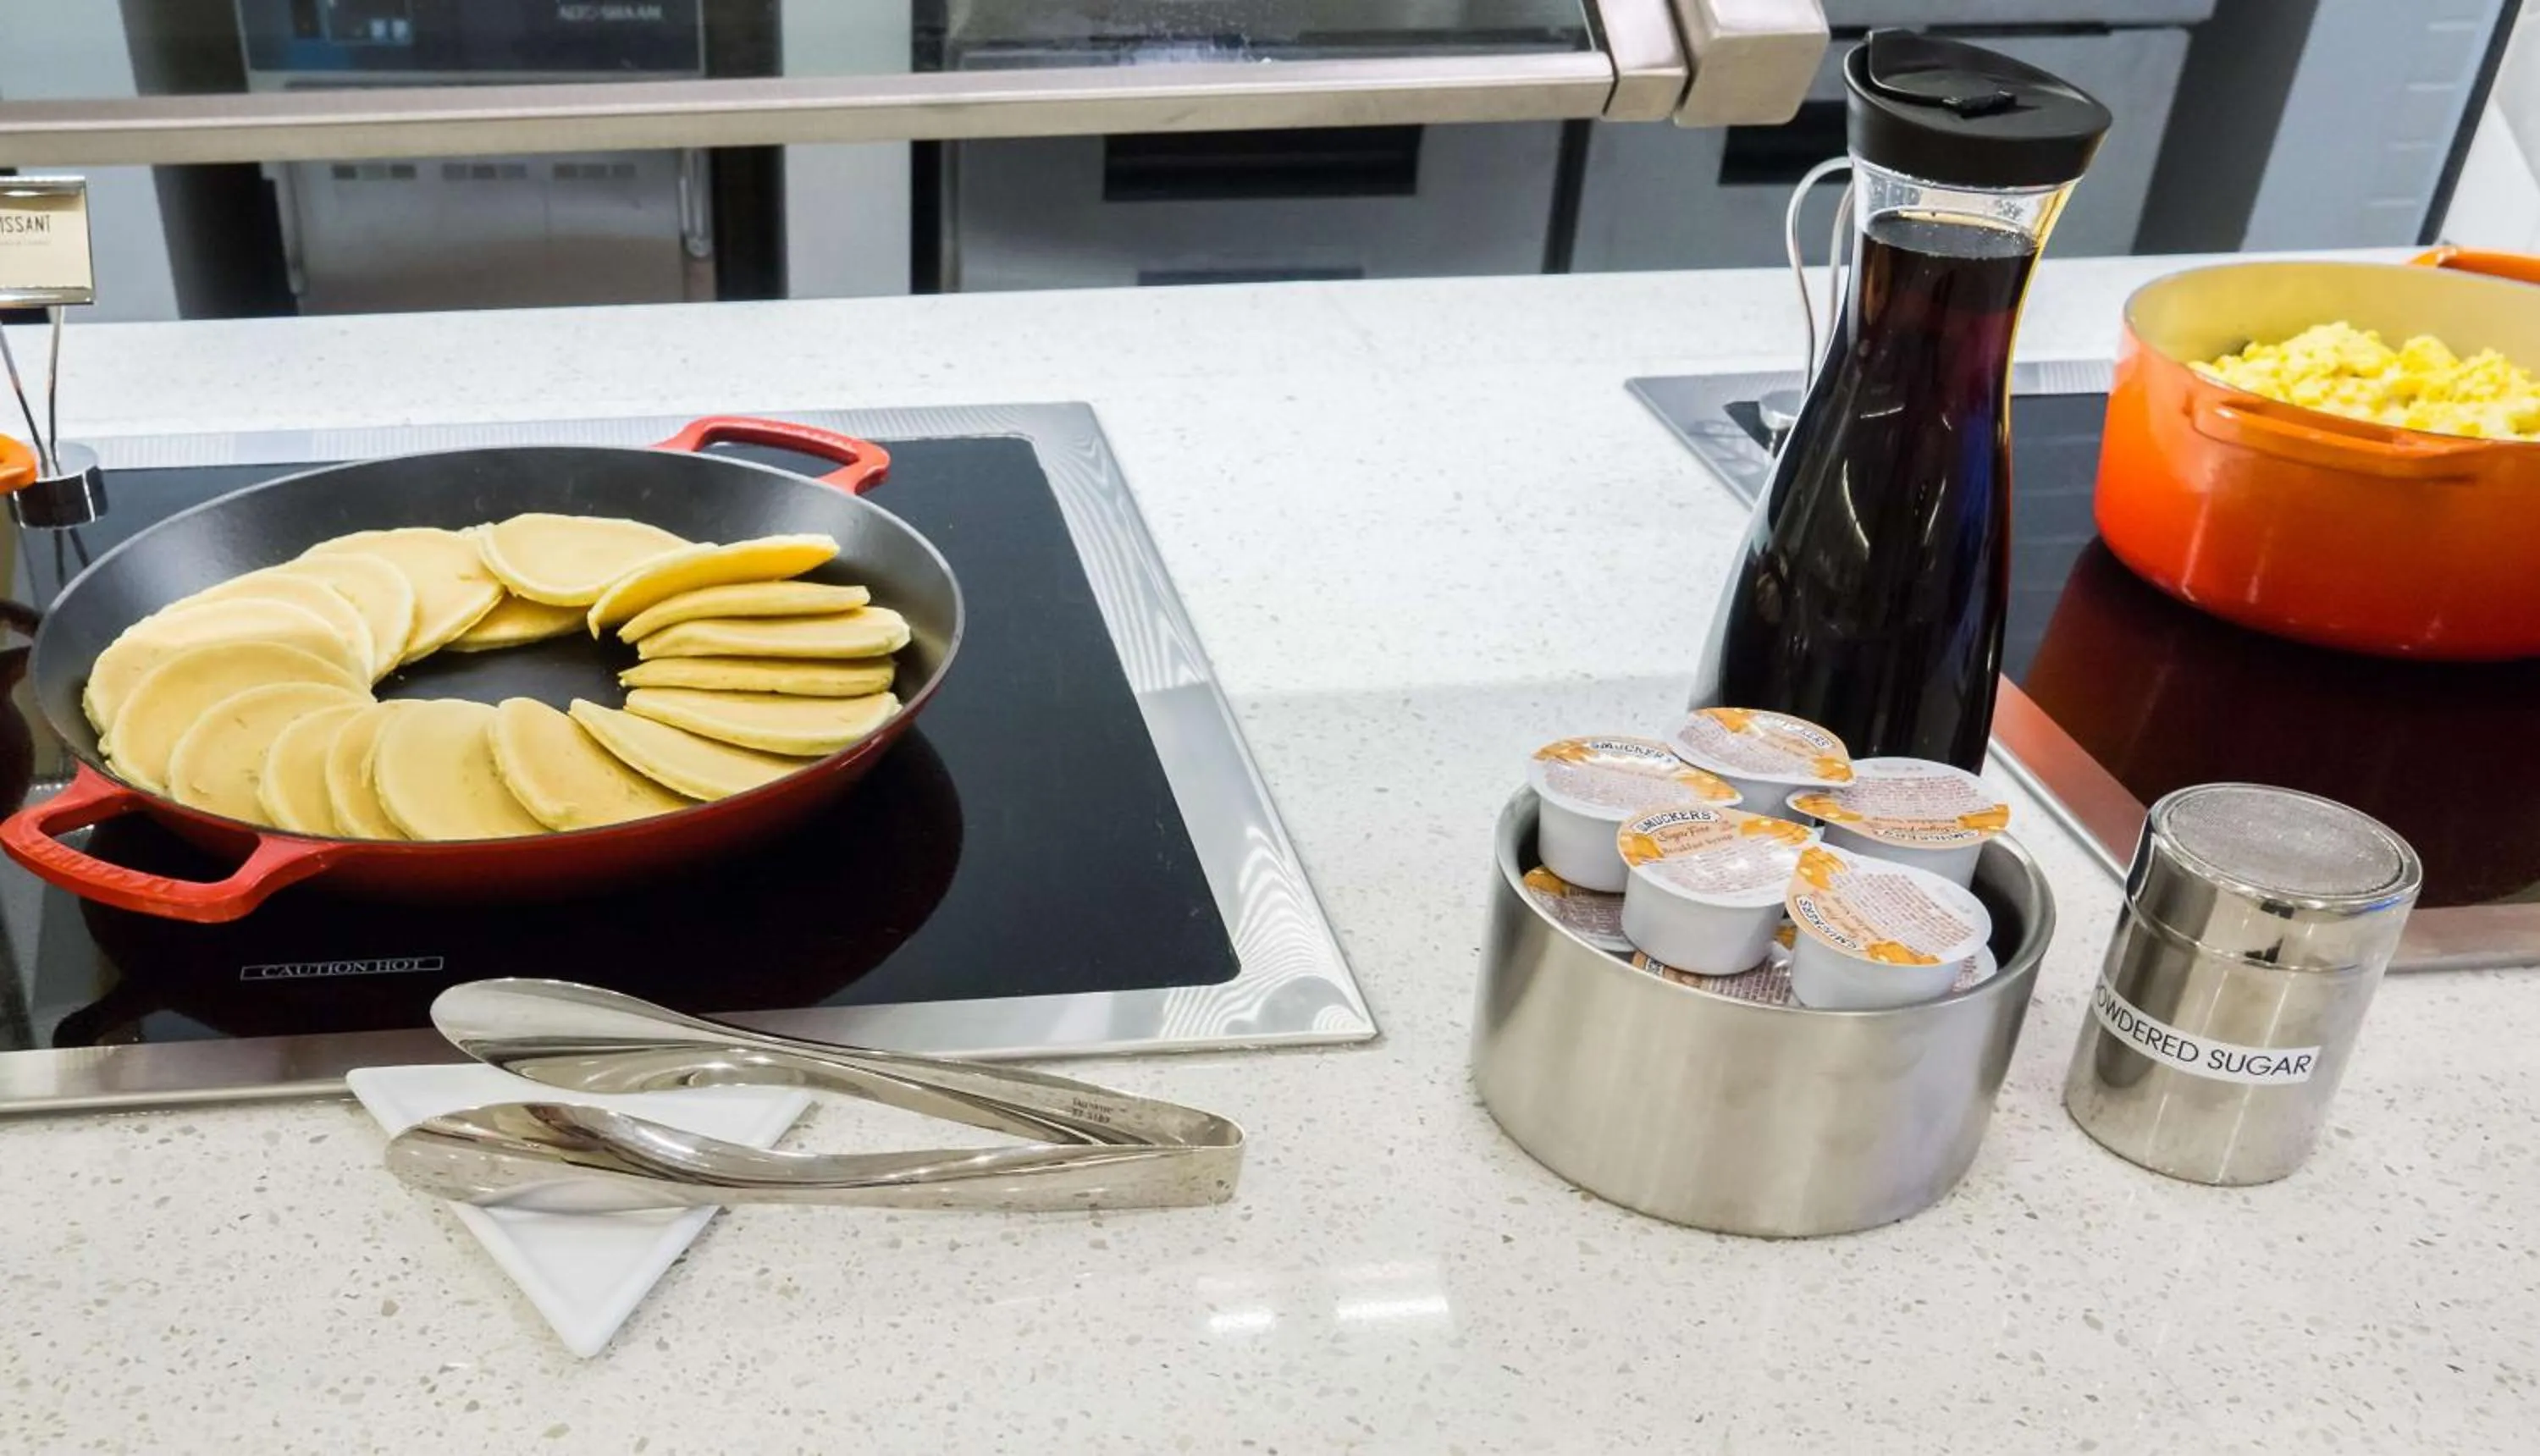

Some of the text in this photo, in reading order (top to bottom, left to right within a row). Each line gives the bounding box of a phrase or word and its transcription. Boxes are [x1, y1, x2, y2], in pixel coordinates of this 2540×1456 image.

[262, 957, 422, 978] CAUTION HOT
[2096, 984, 2311, 1076] OWDERED SUGAR
